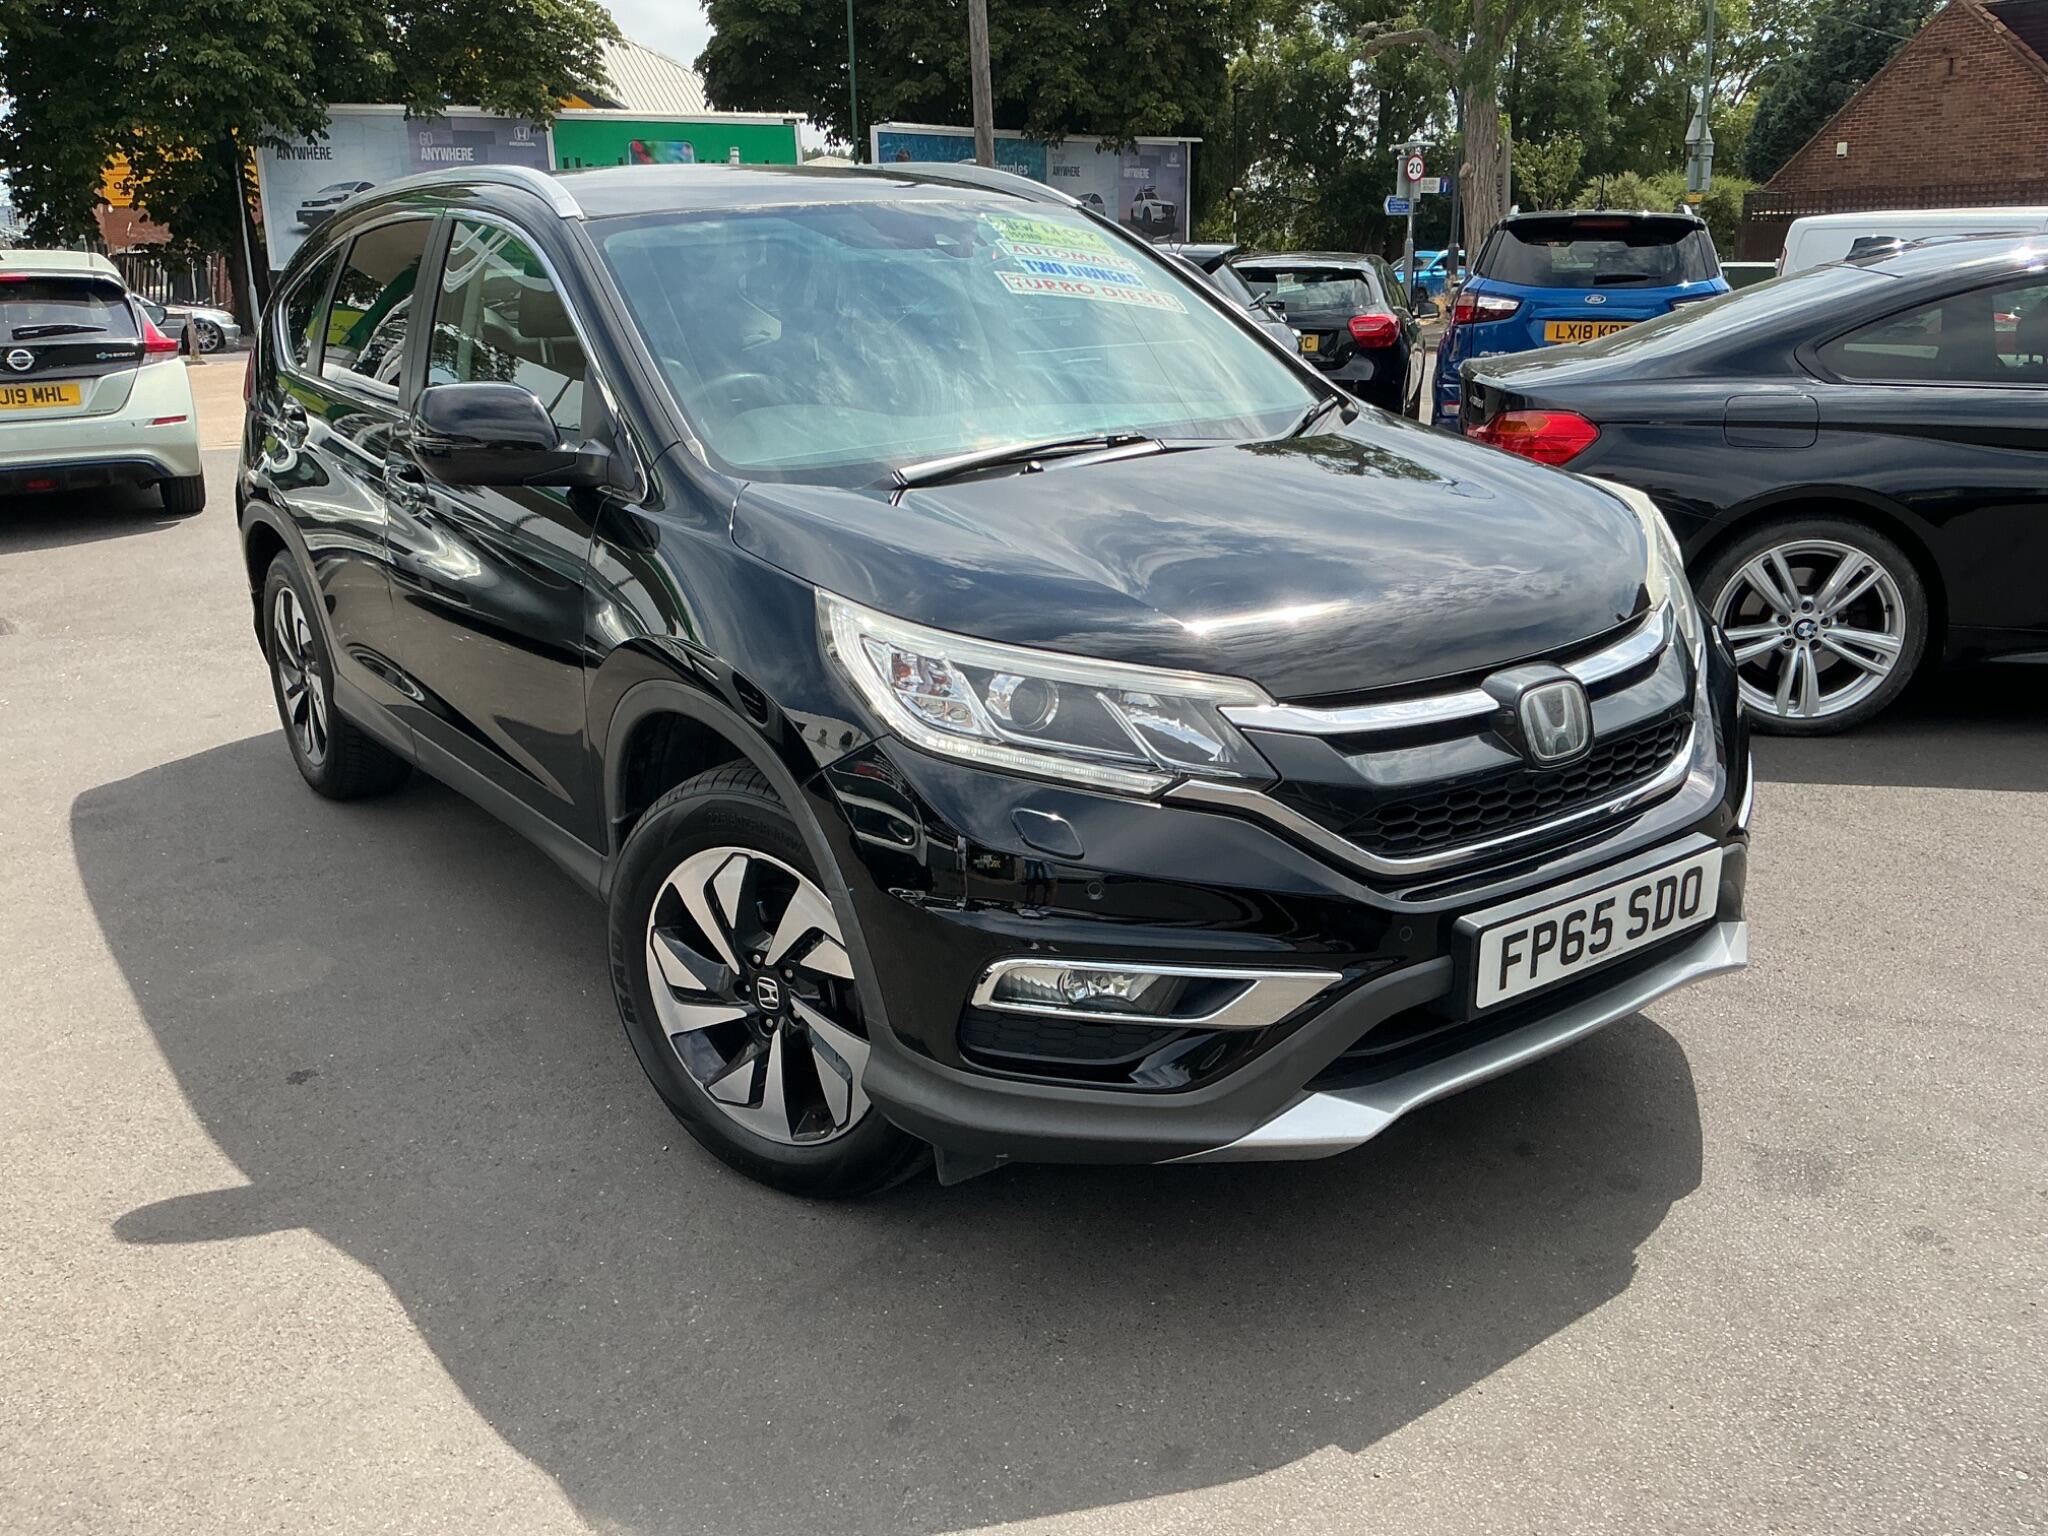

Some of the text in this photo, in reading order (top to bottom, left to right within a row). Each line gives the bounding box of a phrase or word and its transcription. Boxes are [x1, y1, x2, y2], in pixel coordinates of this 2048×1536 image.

[419, 131, 433, 146] GO
[276, 146, 334, 161] ANYWHERE
[420, 147, 474, 162] ANYWHERE
[1408, 162, 1421, 175] 20
[1022, 260, 1068, 275] TWO
[1010, 277, 1173, 306] TURBO DIESEL
[1556, 324, 1593, 340] LX18
[31, 386, 69, 403] MHL
[1498, 865, 1704, 992] FP65 SDO
